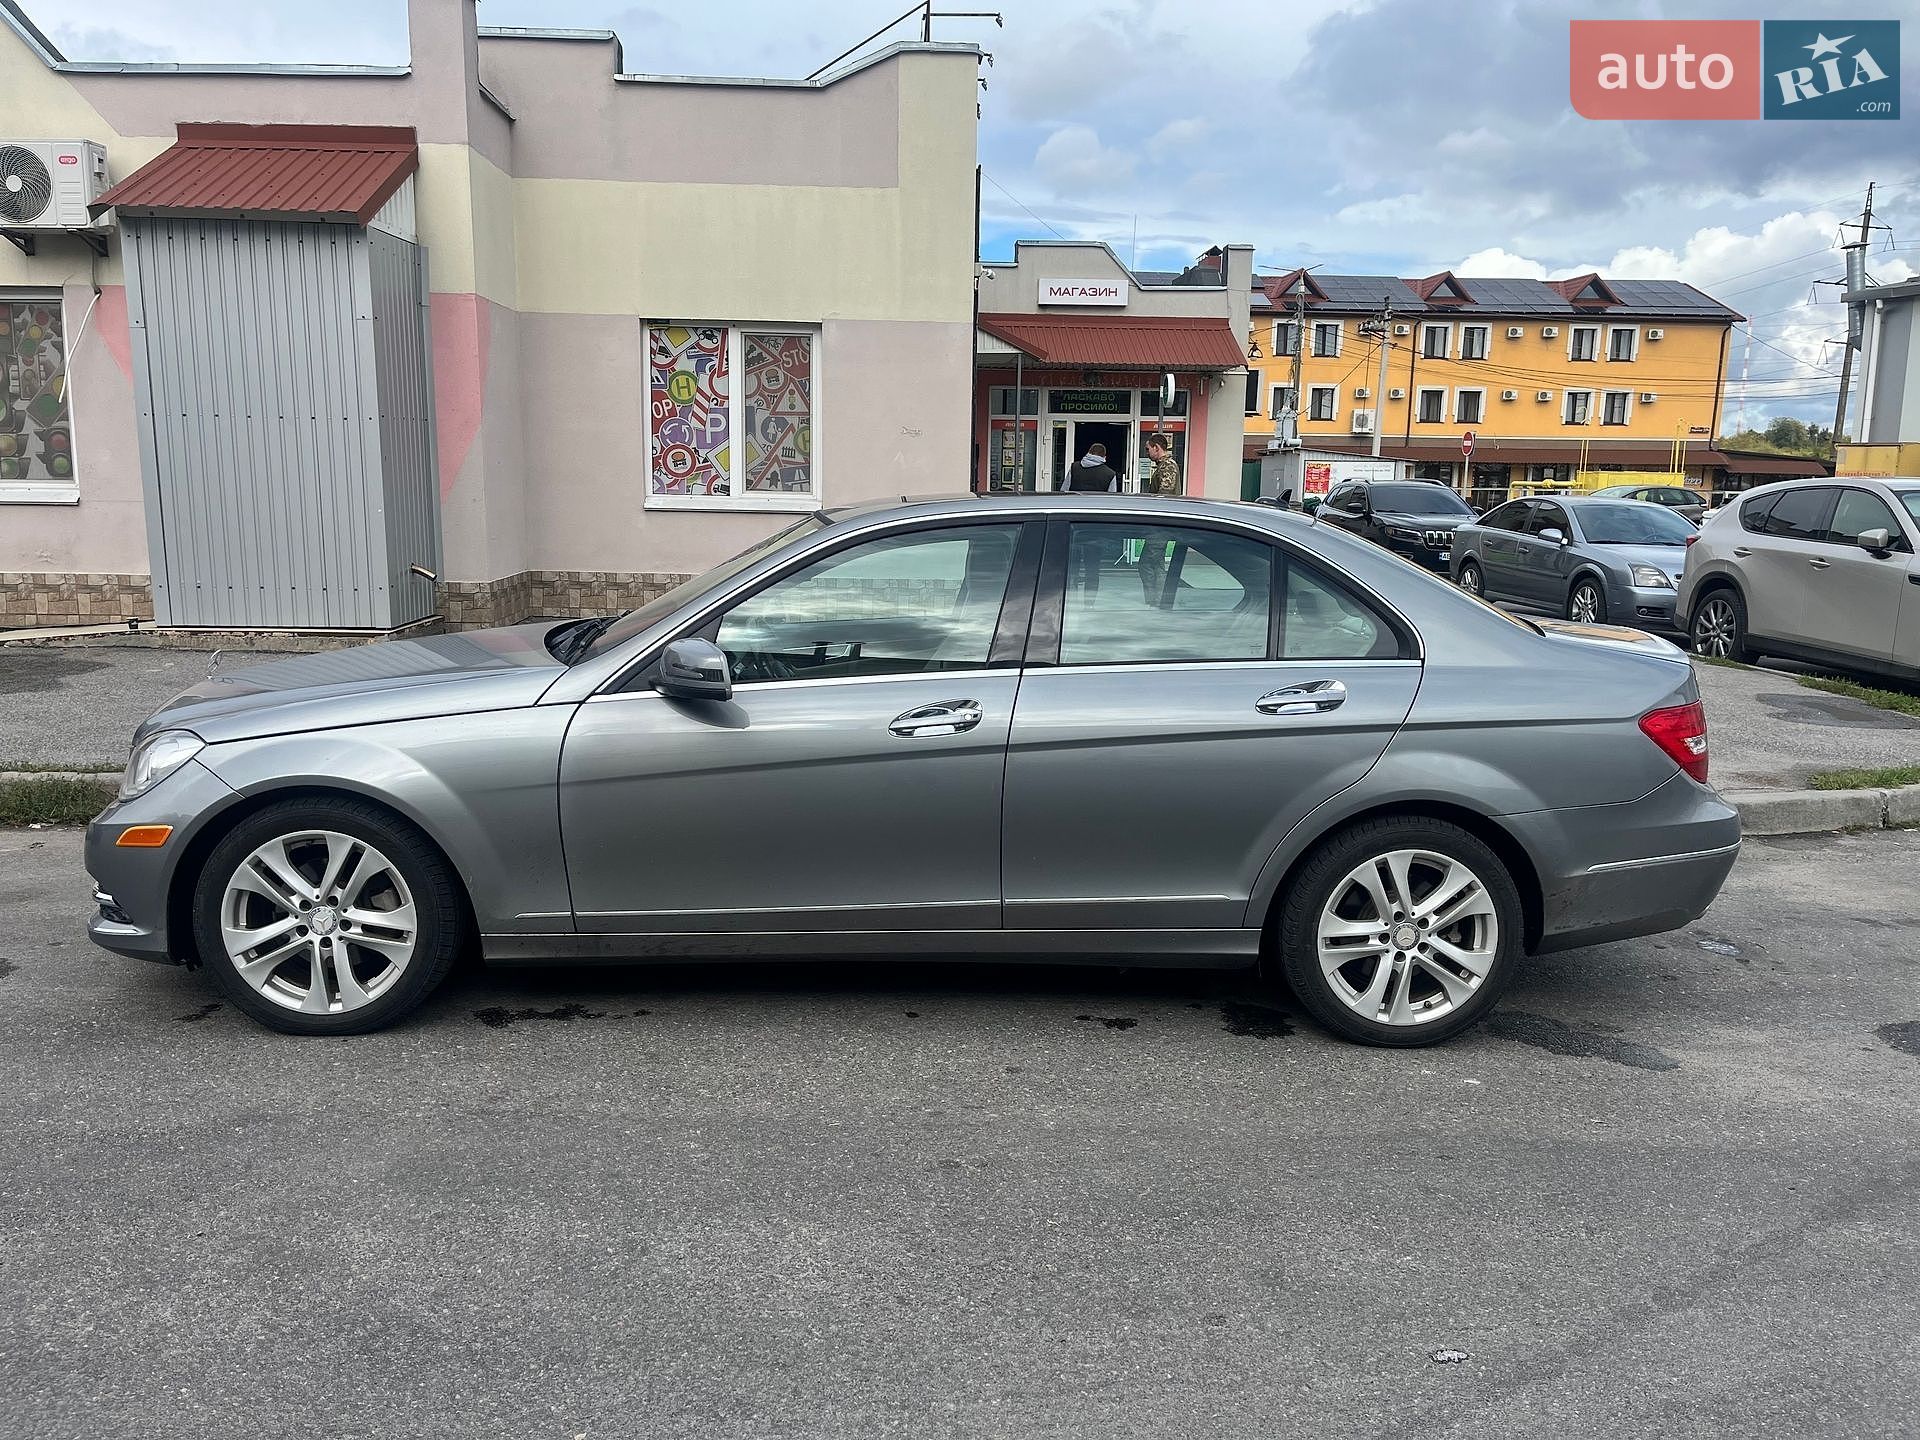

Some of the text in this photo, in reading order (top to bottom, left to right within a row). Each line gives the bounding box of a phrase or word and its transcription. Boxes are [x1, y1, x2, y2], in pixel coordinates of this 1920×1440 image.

[1049, 286, 1118, 297] МАГАЗИН
[1063, 392, 1116, 402] ЛАСКАВО
[1060, 402, 1119, 412] ПРОСИМО!
